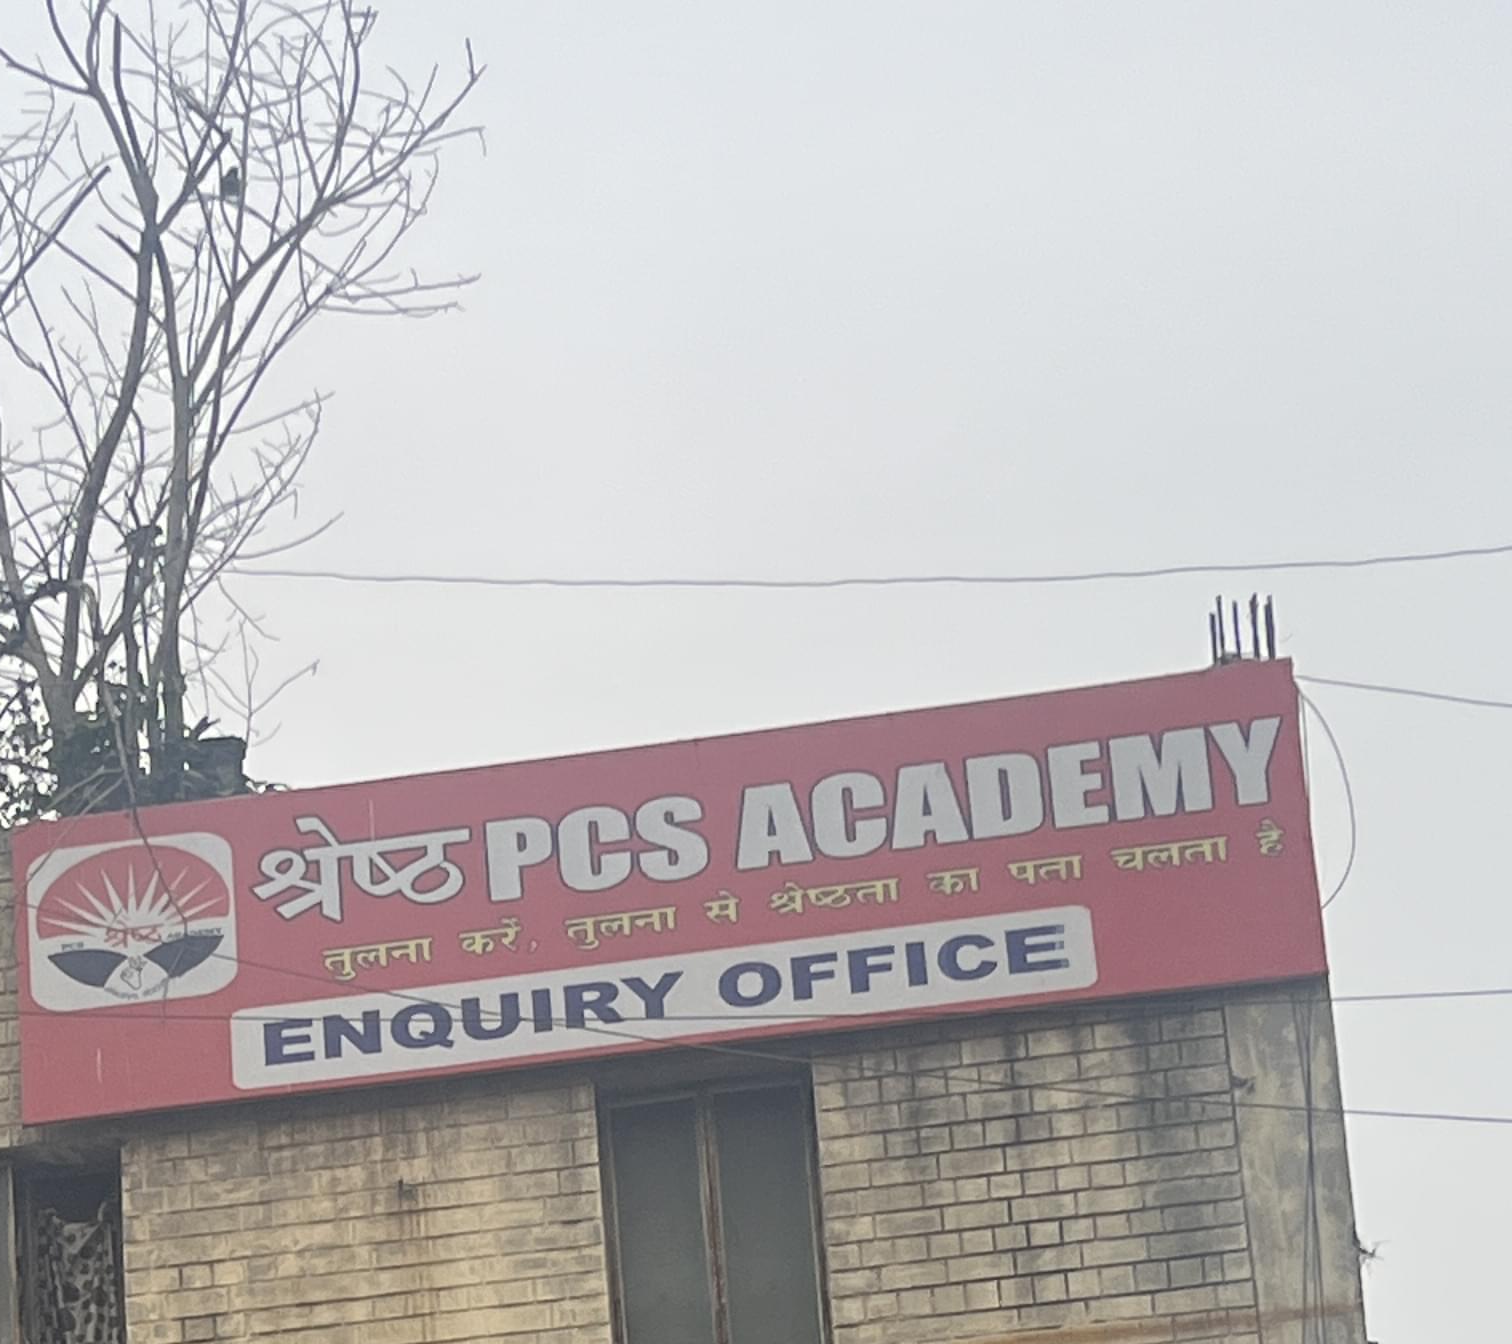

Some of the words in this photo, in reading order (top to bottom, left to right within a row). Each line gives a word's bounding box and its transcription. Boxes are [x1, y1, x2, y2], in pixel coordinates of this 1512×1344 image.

[249, 811, 472, 926] श्रेष्ठ
[485, 795, 704, 900] PCS
[734, 716, 1284, 875] ACADEMY
[321, 935, 434, 979] तुलना
[565, 905, 678, 954] तुलना
[705, 887, 741, 924] से
[771, 870, 901, 917] श्रेष्ठता
[928, 868, 981, 897] का
[1005, 853, 1084, 885] पता
[1113, 836, 1229, 873] चलता
[1256, 821, 1285, 859] है
[260, 971, 687, 1068] ENQUIRY
[717, 924, 1072, 1007] OFFICE
